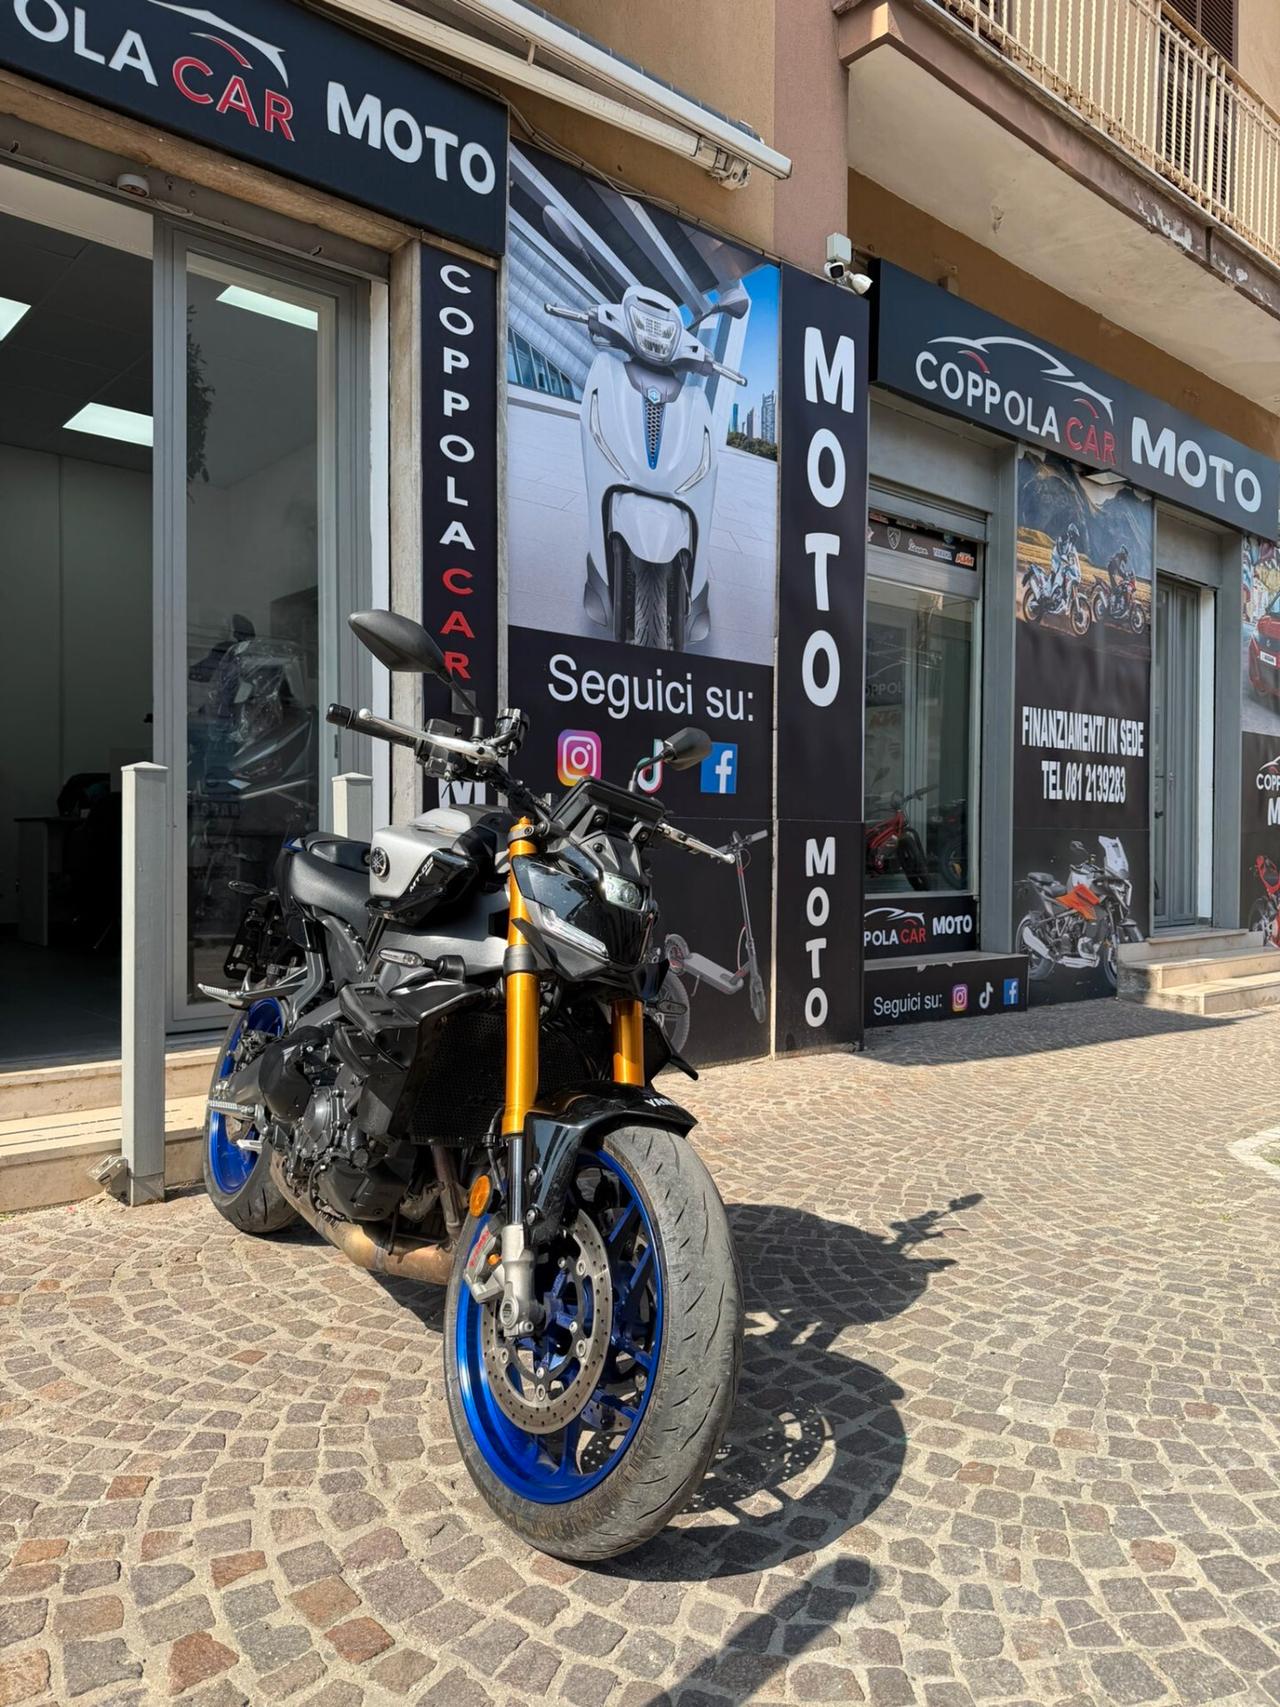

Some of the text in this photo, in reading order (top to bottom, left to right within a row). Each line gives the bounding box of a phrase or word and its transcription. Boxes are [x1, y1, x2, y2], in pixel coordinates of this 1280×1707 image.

[14, 0, 496, 195] OLA CAR MOTO
[915, 351, 1262, 513] COPPOLA CAR MOTO
[802, 326, 856, 707] MOTO
[547, 653, 754, 722] Seguici su:
[1022, 706, 1144, 757] FINANZIAMENTI IN SEDE
[1041, 760, 1126, 803] TEL 081 2139283
[805, 836, 836, 1028] MOTO
[864, 914, 973, 947] POLA CAR MOTO
[873, 992, 921, 1018] Seguici
[924, 993, 943, 1009] su:
